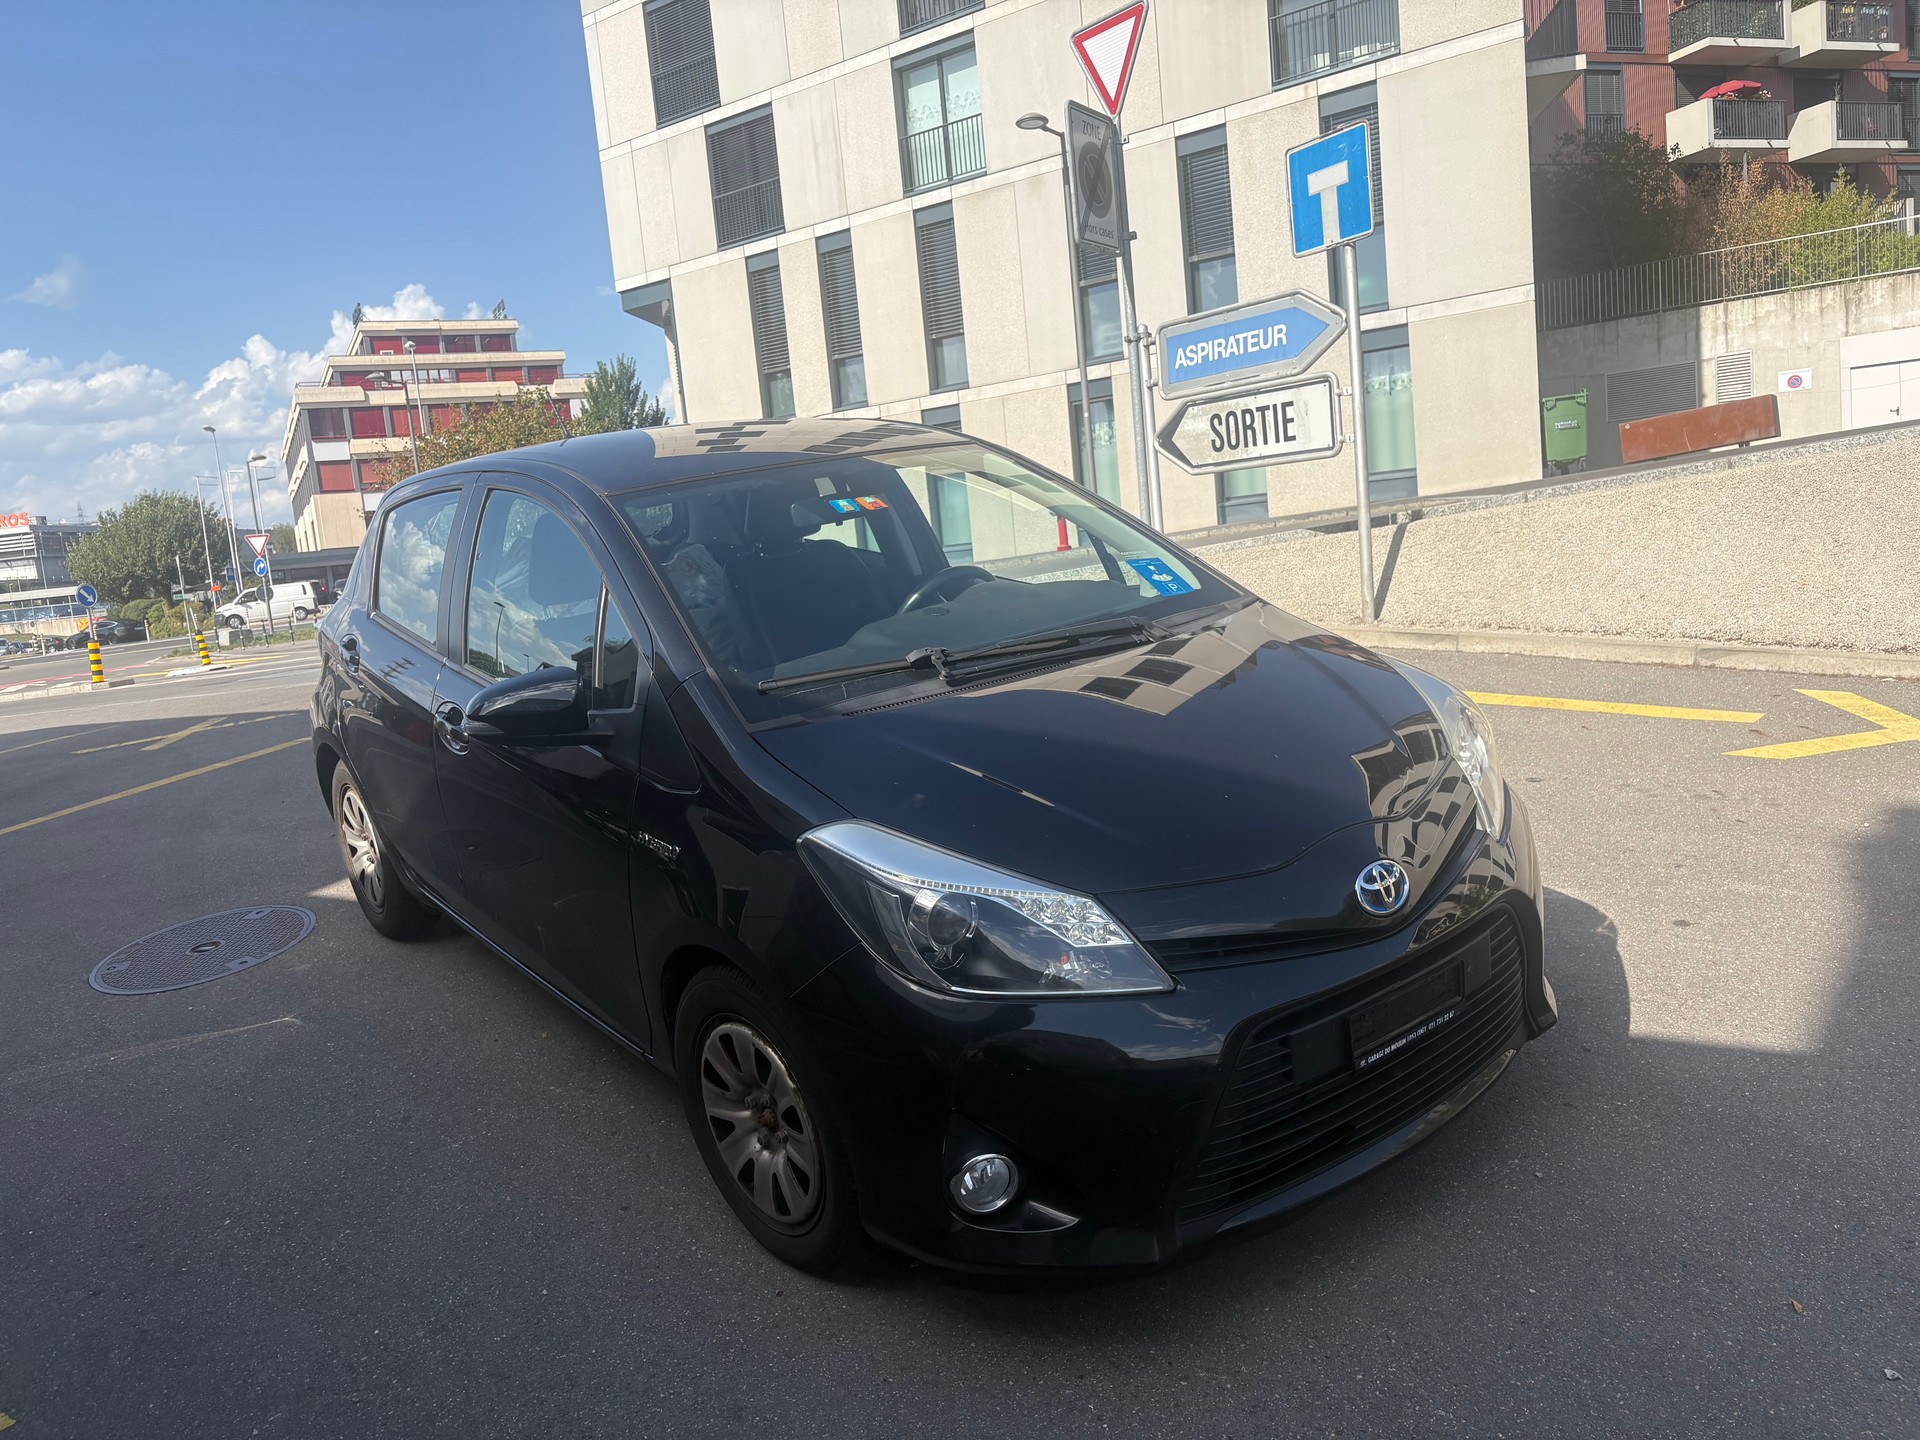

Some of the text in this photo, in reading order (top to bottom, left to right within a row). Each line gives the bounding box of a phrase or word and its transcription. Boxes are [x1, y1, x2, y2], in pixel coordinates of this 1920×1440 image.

[1081, 119, 1101, 141] ZONE
[1086, 223, 1115, 239] ors cases
[1174, 323, 1287, 369] ASPIRATEUR
[1209, 400, 1297, 453] SORTIE
[1368, 1050, 1384, 1064] GARAGE
[1384, 1046, 1391, 1055] DU
[1391, 1038, 1406, 1052] MOULIN
